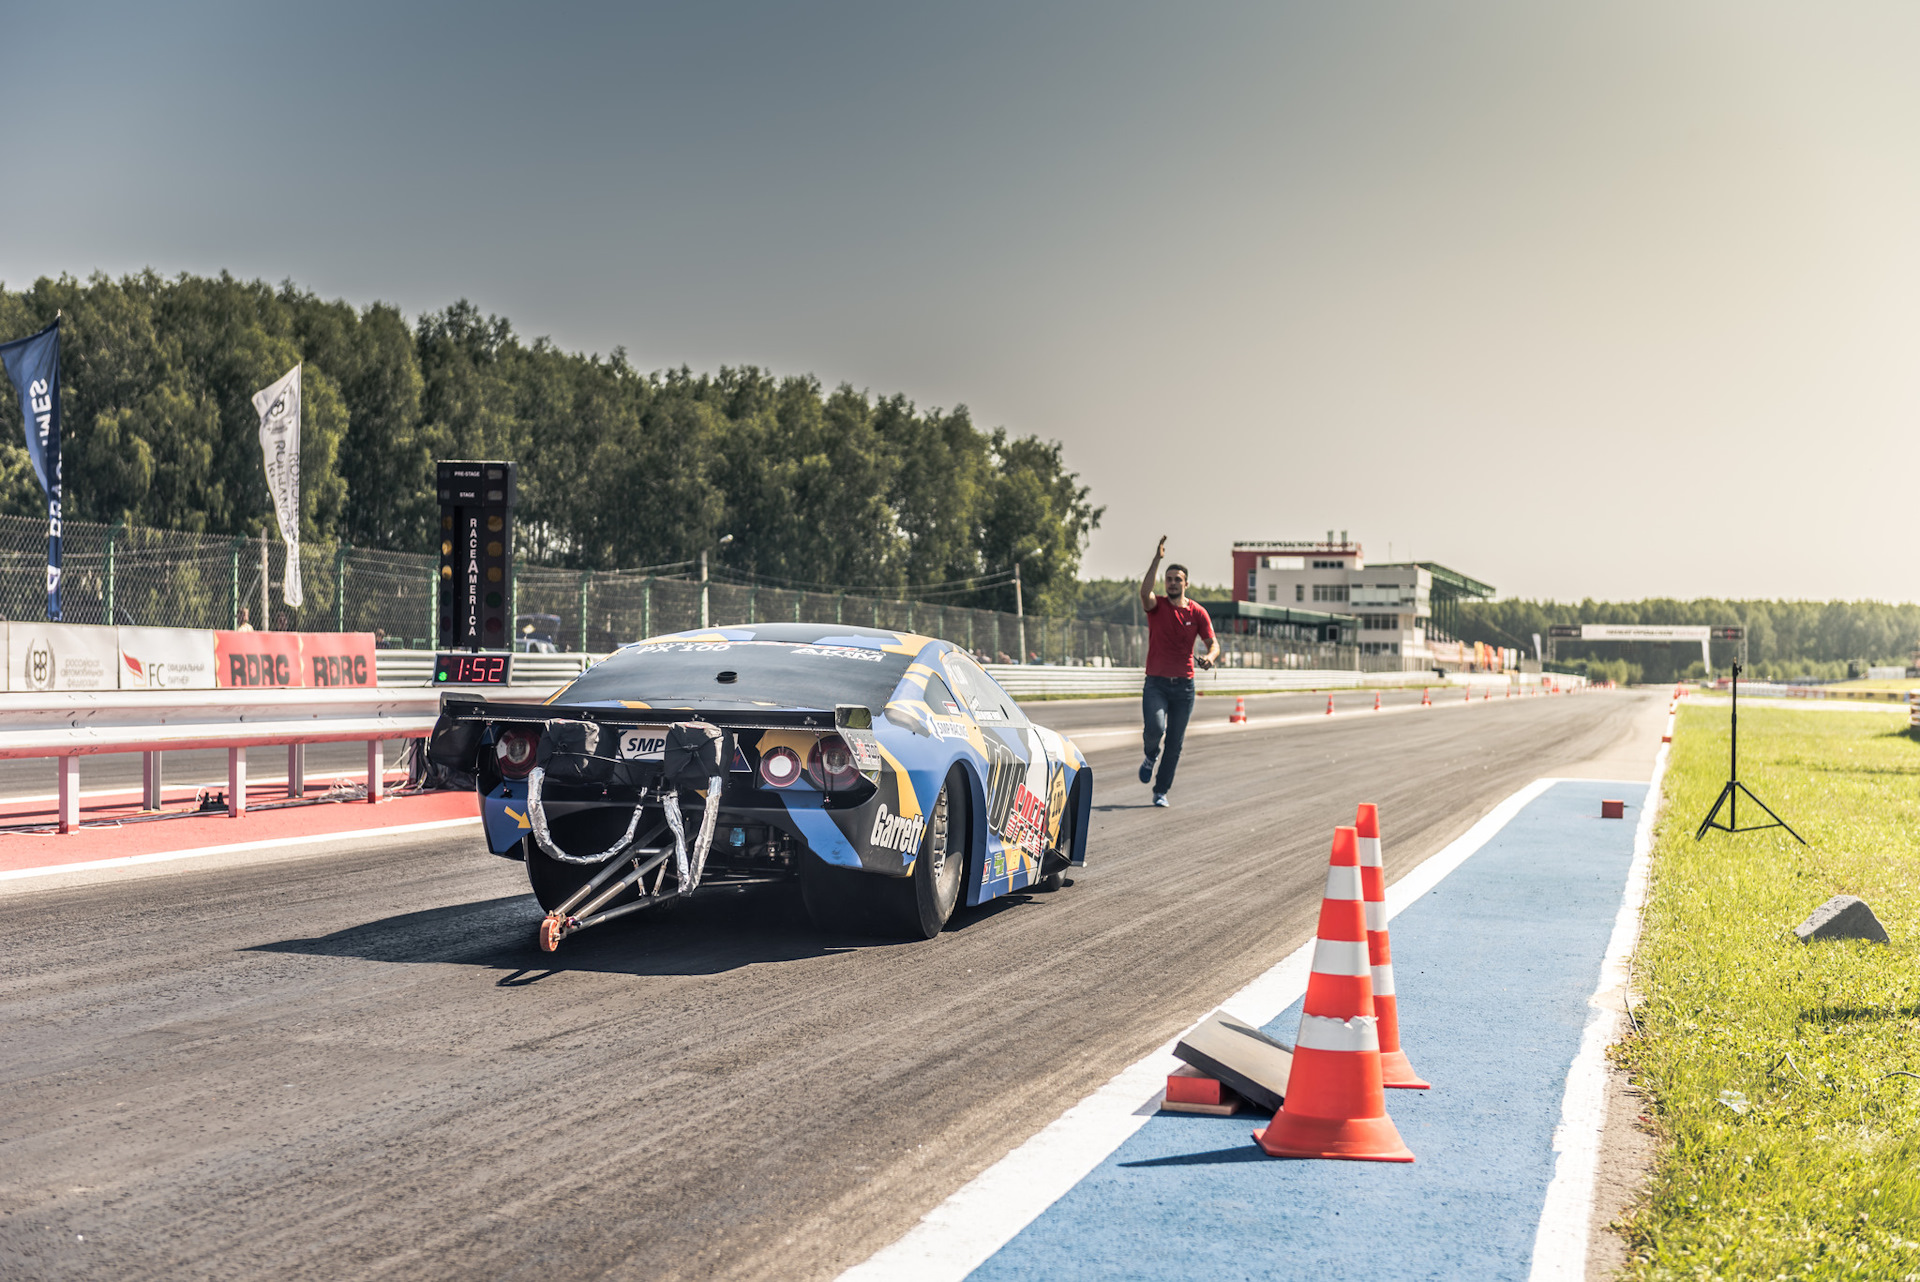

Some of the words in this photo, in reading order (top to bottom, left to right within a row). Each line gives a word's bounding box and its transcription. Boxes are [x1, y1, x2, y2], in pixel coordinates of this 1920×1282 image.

[148, 663, 166, 687] FC
[229, 653, 291, 687] RDRC
[312, 654, 368, 687] RDRC
[458, 658, 505, 682] 1:52
[627, 737, 666, 752] SMP
[870, 803, 924, 855] Garrett
